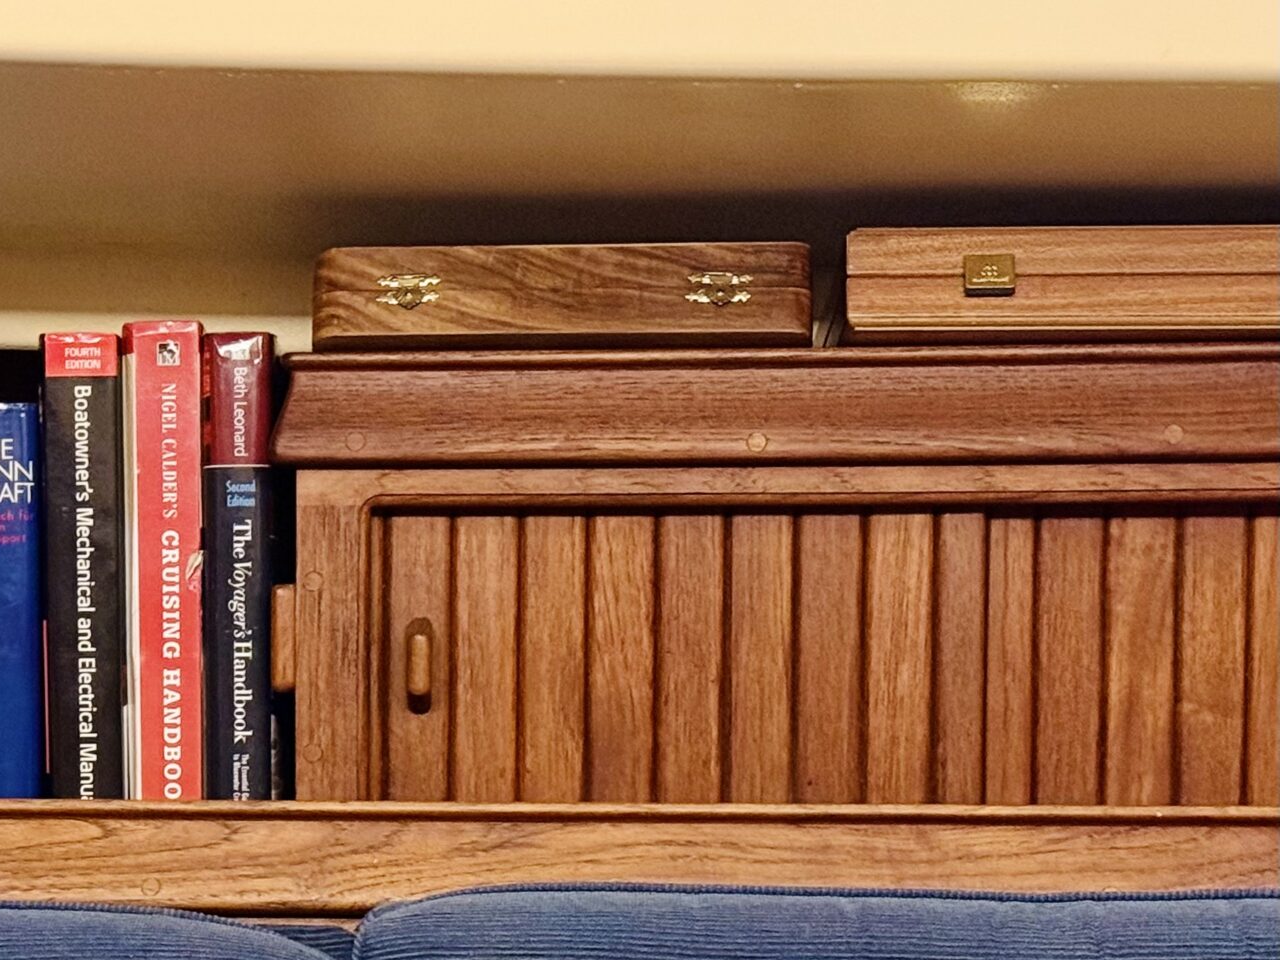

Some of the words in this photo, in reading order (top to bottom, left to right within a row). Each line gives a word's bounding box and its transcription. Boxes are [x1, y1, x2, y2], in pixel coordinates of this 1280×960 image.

[64, 347, 101, 357] FOURTH
[64, 359, 101, 369] EDITION
[161, 383, 176, 433] NIGEL
[233, 366, 248, 398] Beth
[74, 385, 94, 502] Boatowner's
[233, 401, 249, 457] Leonard
[161, 438, 179, 519] CALDER'S
[226, 480, 256, 493] Second
[226, 495, 256, 508] Edition
[75, 508, 96, 612] Mechanical
[233, 519, 254, 558] The
[160, 530, 182, 659] CRUISING
[229, 560, 254, 639] Voyager's
[78, 618, 96, 651] and
[79, 658, 97, 737] Electrical
[233, 640, 255, 744] Handbook
